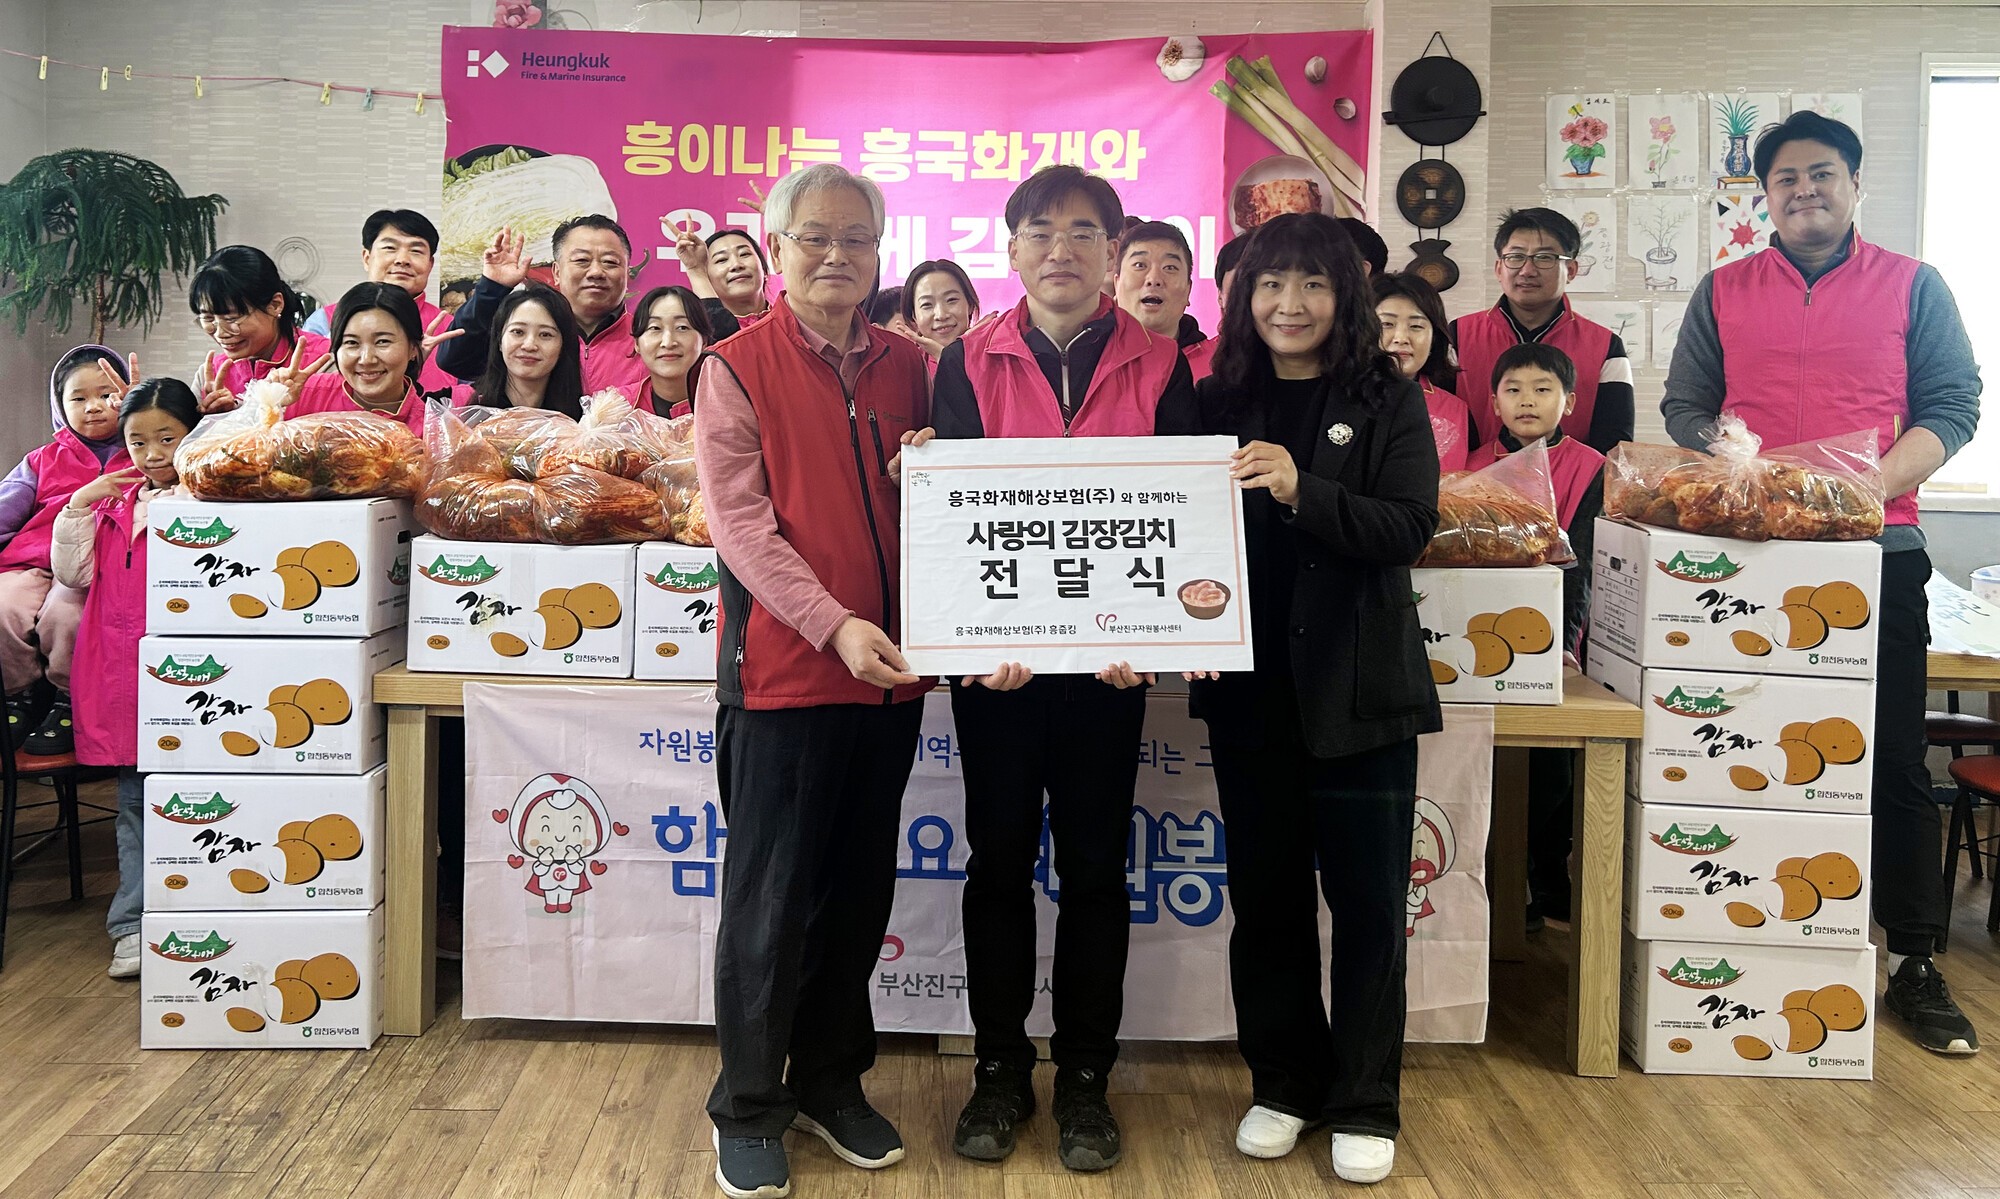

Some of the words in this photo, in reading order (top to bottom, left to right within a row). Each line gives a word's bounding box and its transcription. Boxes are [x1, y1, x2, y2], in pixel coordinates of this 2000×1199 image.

[521, 52, 610, 71] Heungkuk
[520, 71, 539, 79] Fire
[540, 72, 548, 80] &
[548, 73, 580, 81] Marine
[582, 74, 626, 82] Insurance
[622, 121, 842, 177] 흥이나는
[859, 127, 1147, 182] 흥국화재와
[948, 487, 1115, 507] 흥국화재해상보험(주)
[1120, 492, 1133, 504] 와
[1138, 491, 1188, 504] 함께하는
[967, 519, 1056, 551] 사랑의
[1061, 518, 1176, 550] 김장김치
[955, 625, 1046, 636] 흥국화재해상보험(주)
